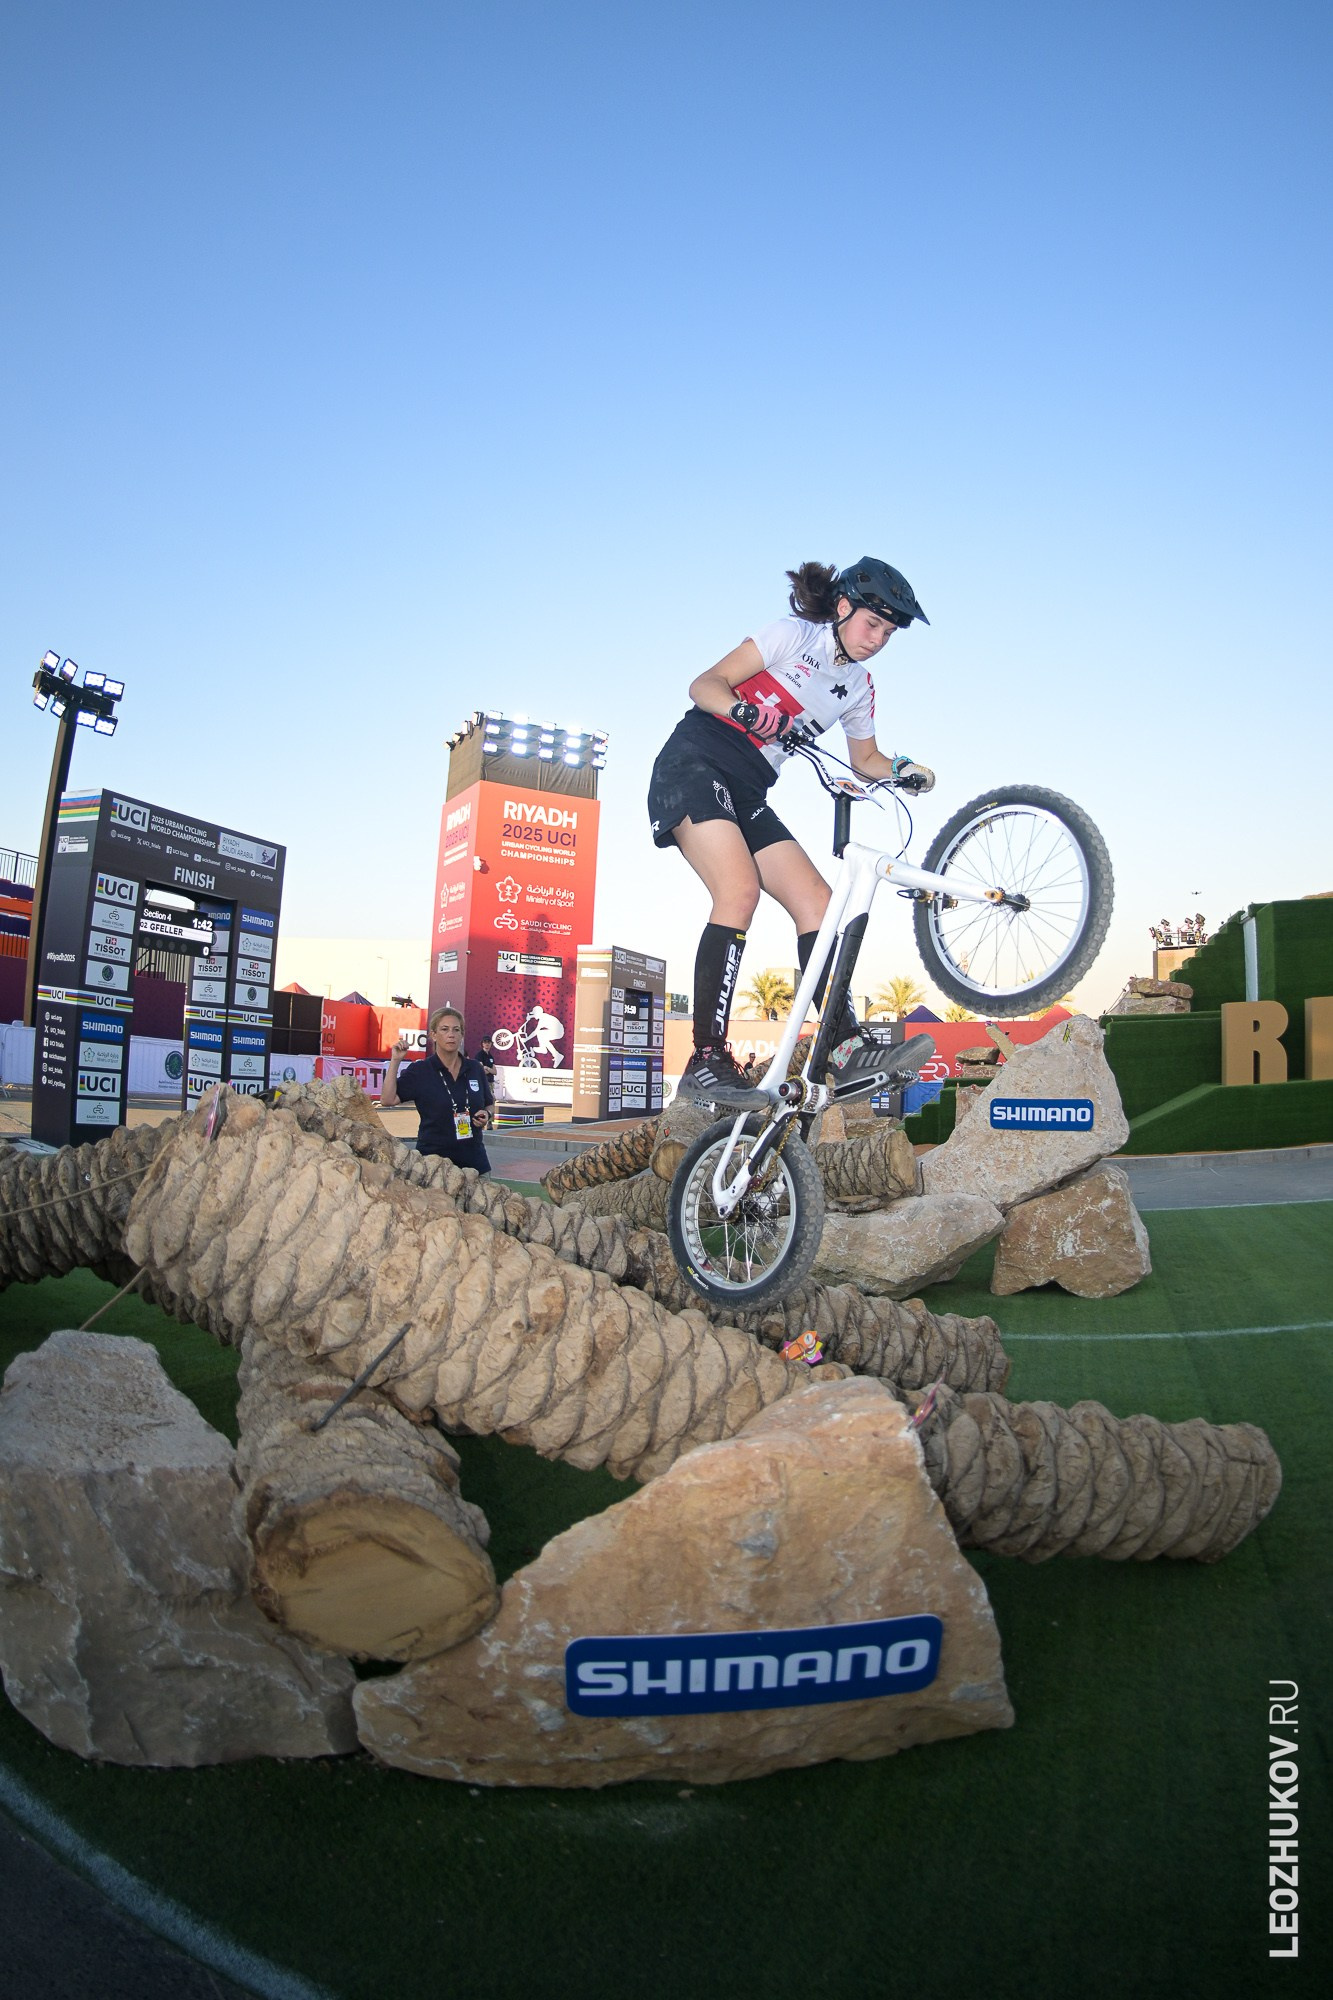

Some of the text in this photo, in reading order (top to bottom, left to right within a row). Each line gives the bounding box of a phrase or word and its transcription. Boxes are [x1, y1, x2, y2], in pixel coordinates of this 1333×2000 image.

[118, 803, 147, 828] UCI
[503, 800, 578, 830] RIYADH
[151, 815, 207, 838] 2025 URBAN CYCLING
[150, 822, 216, 849] WORLD CHAMPIONSHIPS
[502, 823, 577, 847] 2025 UCI
[236, 849, 254, 860] ARABIA
[501, 840, 577, 857] URBAN CYCLING WORLD
[500, 849, 575, 867] CHAMPIONSHIPS
[174, 866, 215, 890] FINISH
[104, 878, 134, 902] UCI
[526, 884, 575, 901] وزارة الرياضة
[525, 894, 550, 906] Ministry
[556, 898, 575, 908] Sport
[143, 908, 172, 922] Section 4
[242, 914, 274, 928] SHIMANO
[149, 922, 184, 937] GFELLER
[192, 917, 213, 932] 1:42
[520, 919, 542, 928] SAUDI
[543, 921, 573, 931] CYCLING
[95, 942, 126, 957] TISSOT
[202, 946, 209, 956] 0
[502, 953, 519, 962] UCI
[198, 964, 223, 974] TISSOT
[241, 968, 266, 979] TISSOT
[633, 979, 646, 989] FINISH
[51, 989, 65, 1000] UCI
[96, 995, 114, 1007] UCI
[200, 1009, 214, 1019] UCI
[243, 1014, 258, 1023] UCI
[82, 1021, 124, 1034] SHIMANO
[190, 1031, 222, 1043] SHIMANO
[232, 1035, 265, 1046] SHIMANO
[86, 1075, 116, 1093] UCI
[193, 1077, 216, 1092] UC
[236, 1083, 260, 1095] UCI
[626, 1085, 644, 1094] UCI
[523, 1115, 536, 1125] UCI
[993, 1106, 1091, 1122] SHIMANO
[576, 1638, 931, 1696] SHIMANO
